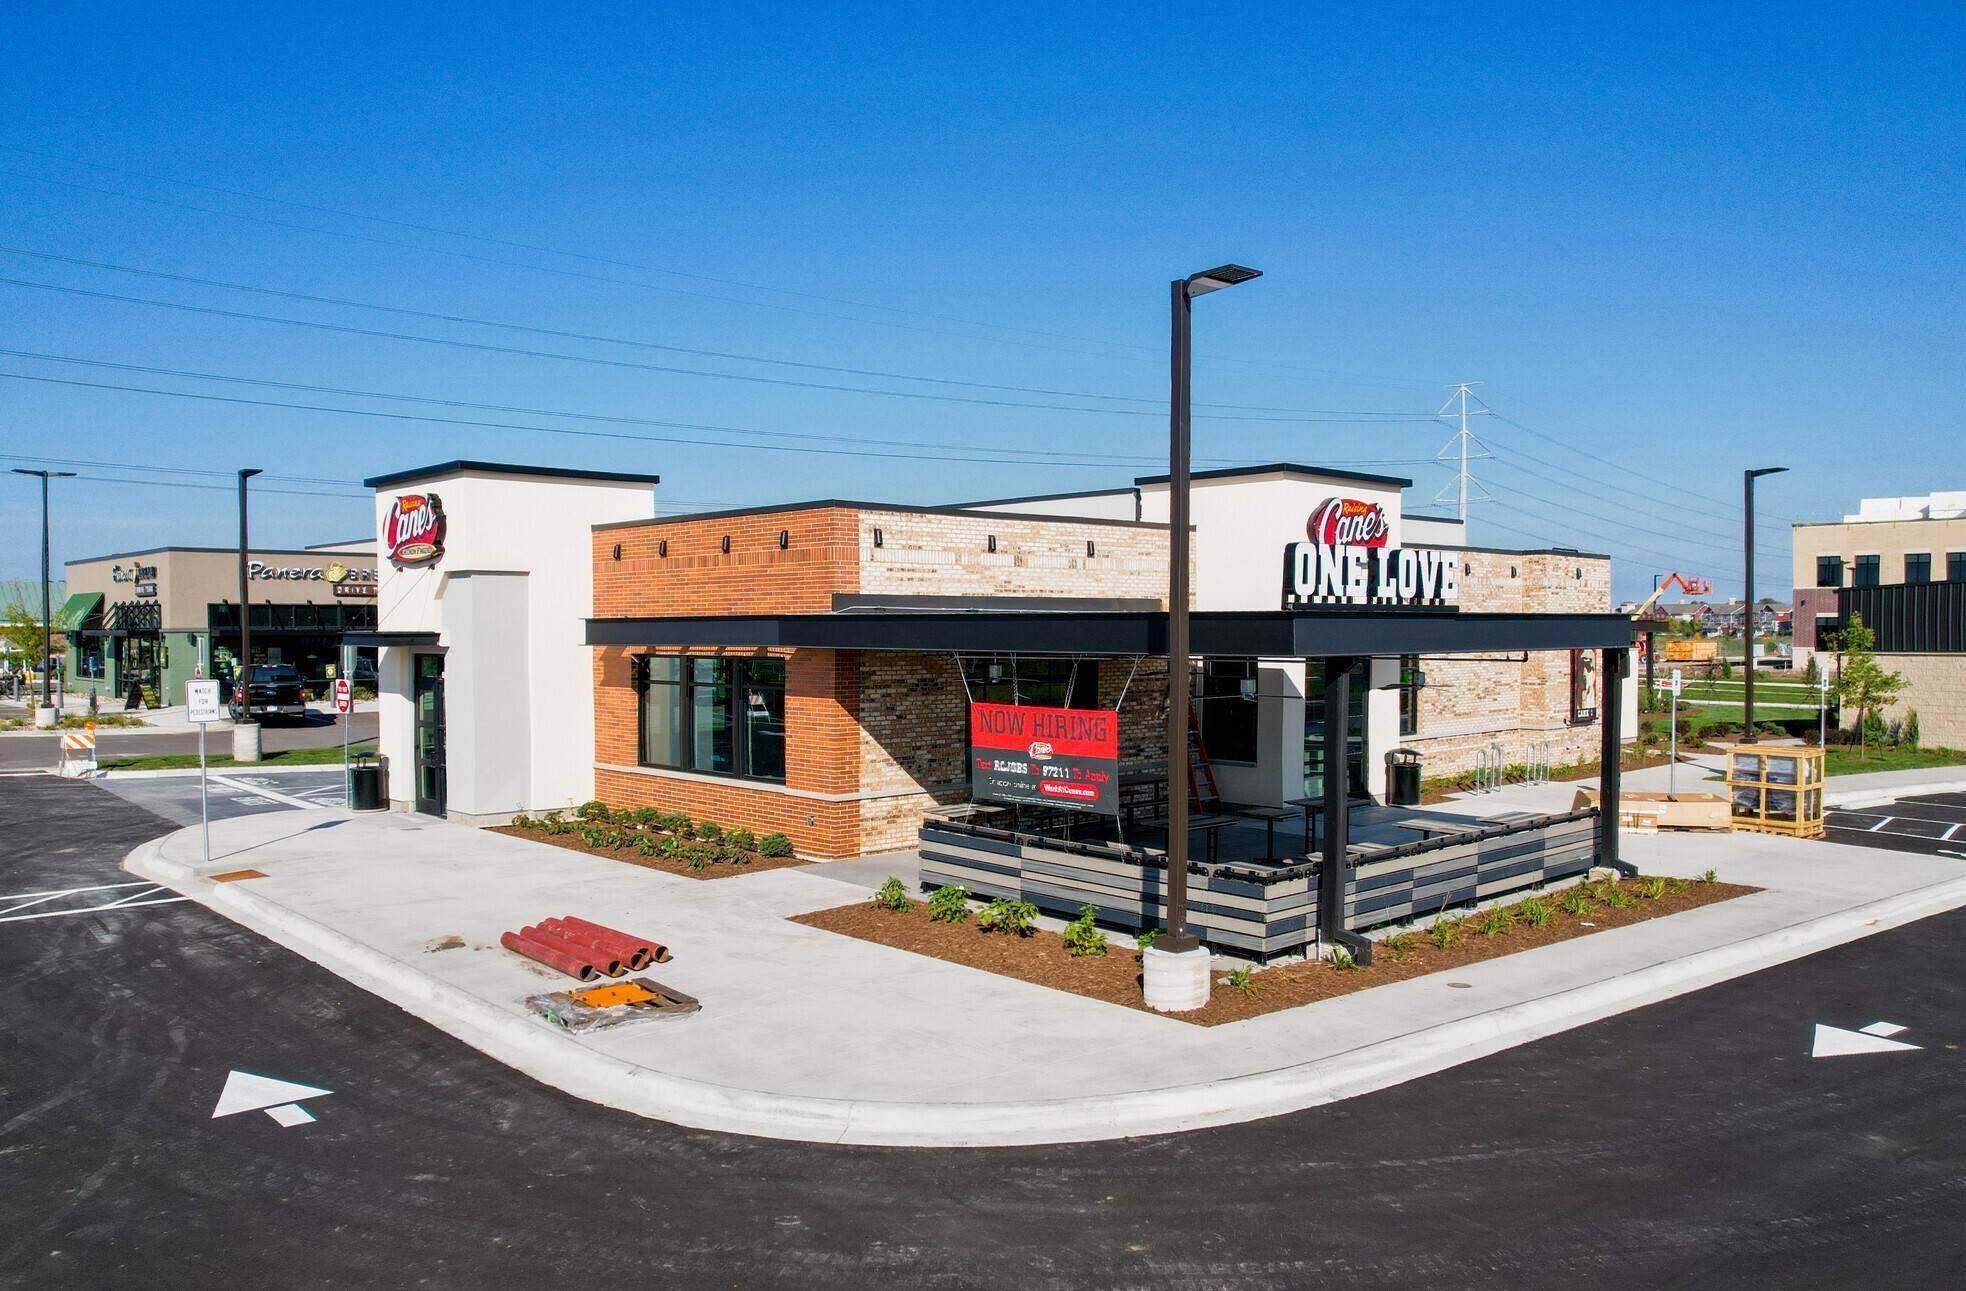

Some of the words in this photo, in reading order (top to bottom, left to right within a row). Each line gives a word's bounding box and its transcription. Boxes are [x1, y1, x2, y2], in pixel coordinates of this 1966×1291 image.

[1343, 502, 1368, 514] Raising
[383, 494, 436, 554] Cane's
[1319, 497, 1390, 545] Cane's
[247, 560, 324, 580] Panera
[1294, 541, 1368, 598] ONE
[1377, 549, 1459, 600] LOVE
[337, 586, 367, 594] DRIVE
[194, 687, 211, 695] WATCH
[979, 709, 1026, 736] NOW
[1032, 713, 1108, 742] HIRING
[1042, 765, 1069, 778] 97211
